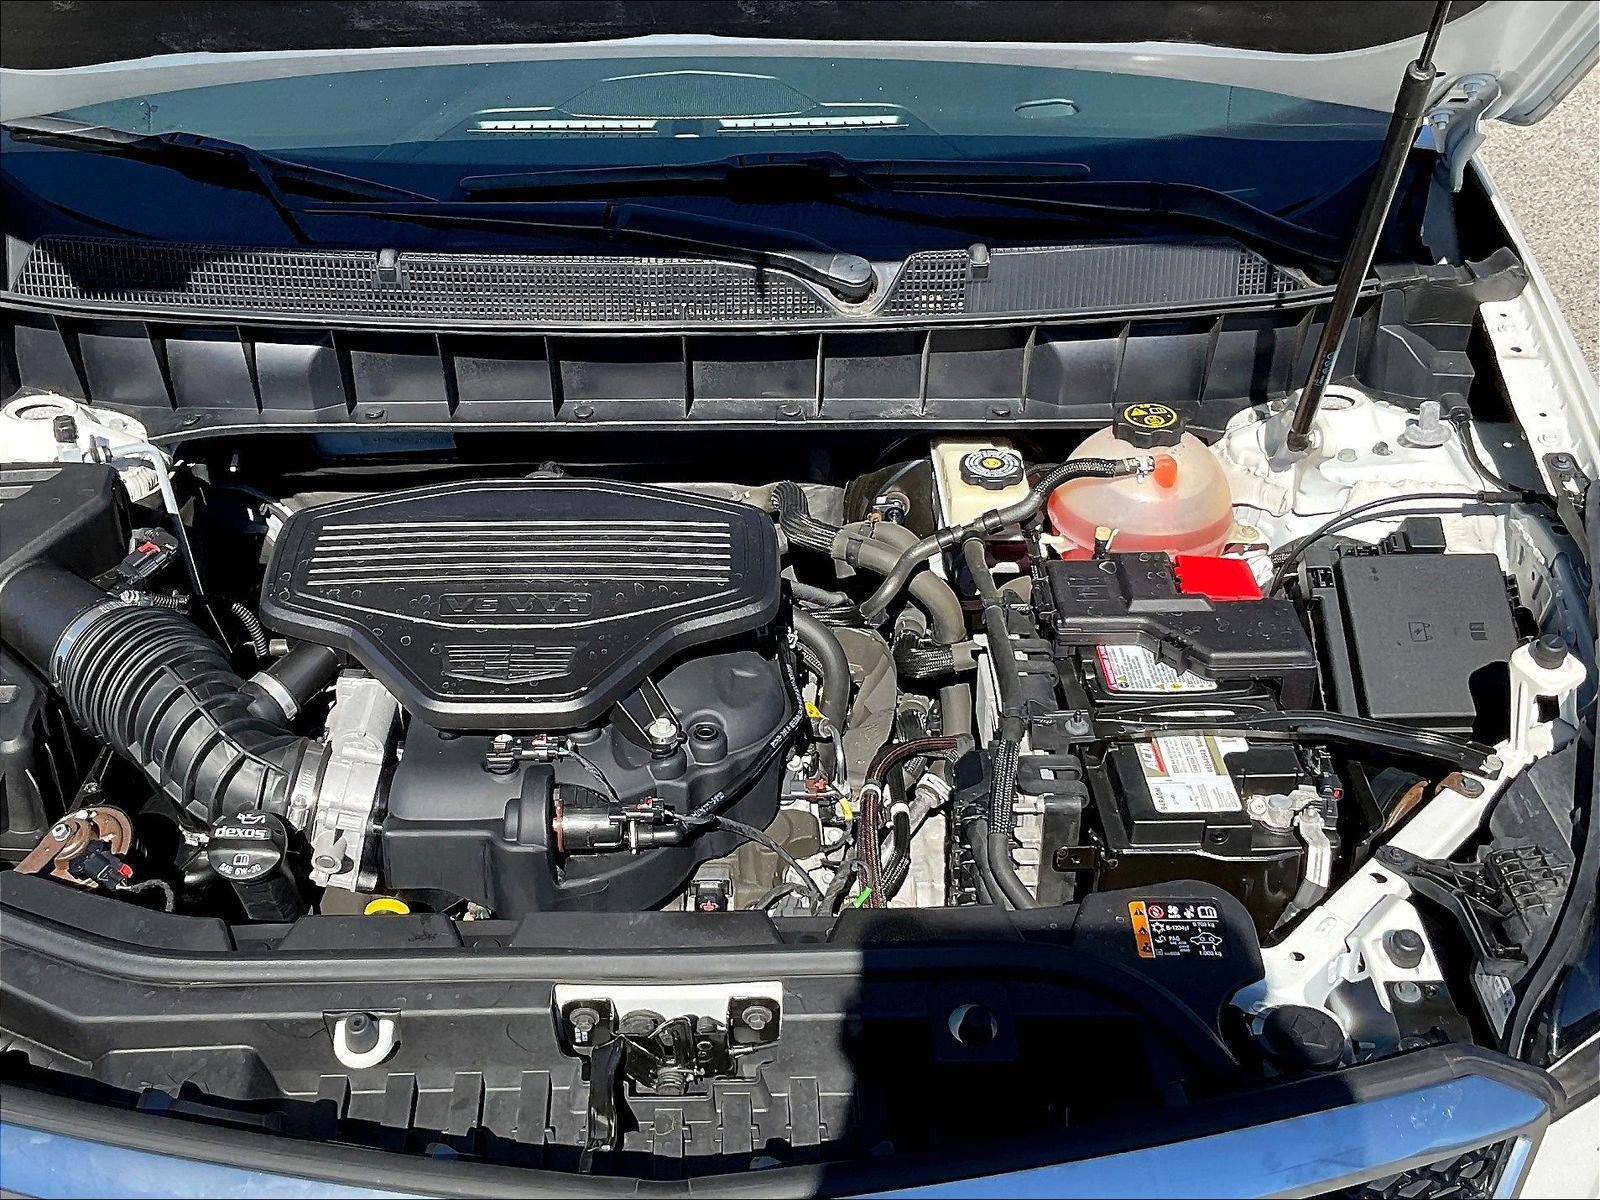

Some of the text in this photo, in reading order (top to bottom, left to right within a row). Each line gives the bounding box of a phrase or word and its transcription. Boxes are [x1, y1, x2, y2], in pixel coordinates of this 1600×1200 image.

[446, 596, 587, 612] V6 VVT
[214, 825, 267, 838] dexos
[219, 862, 234, 874] SAE
